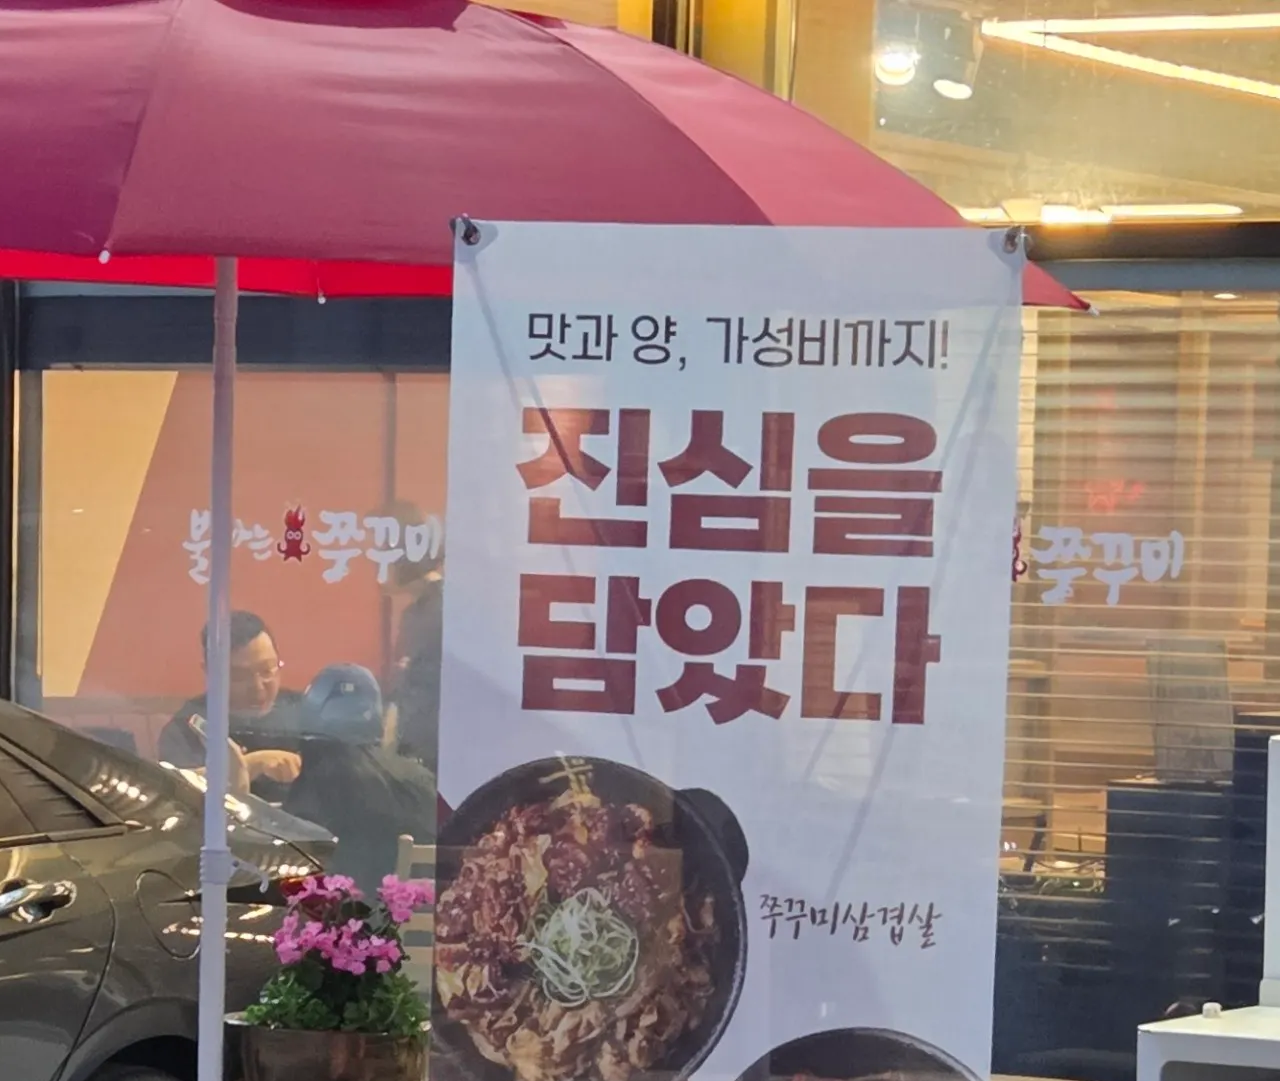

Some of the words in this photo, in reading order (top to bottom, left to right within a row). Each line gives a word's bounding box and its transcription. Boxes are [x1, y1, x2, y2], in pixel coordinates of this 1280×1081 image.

[527, 312, 619, 361] 맛과
[631, 314, 688, 370] 양,
[706, 315, 950, 370] 가성비까지!
[515, 407, 943, 559] 진심을
[517, 573, 941, 725] 담았다
[758, 894, 943, 949] 쭈꾸미삼겹살
